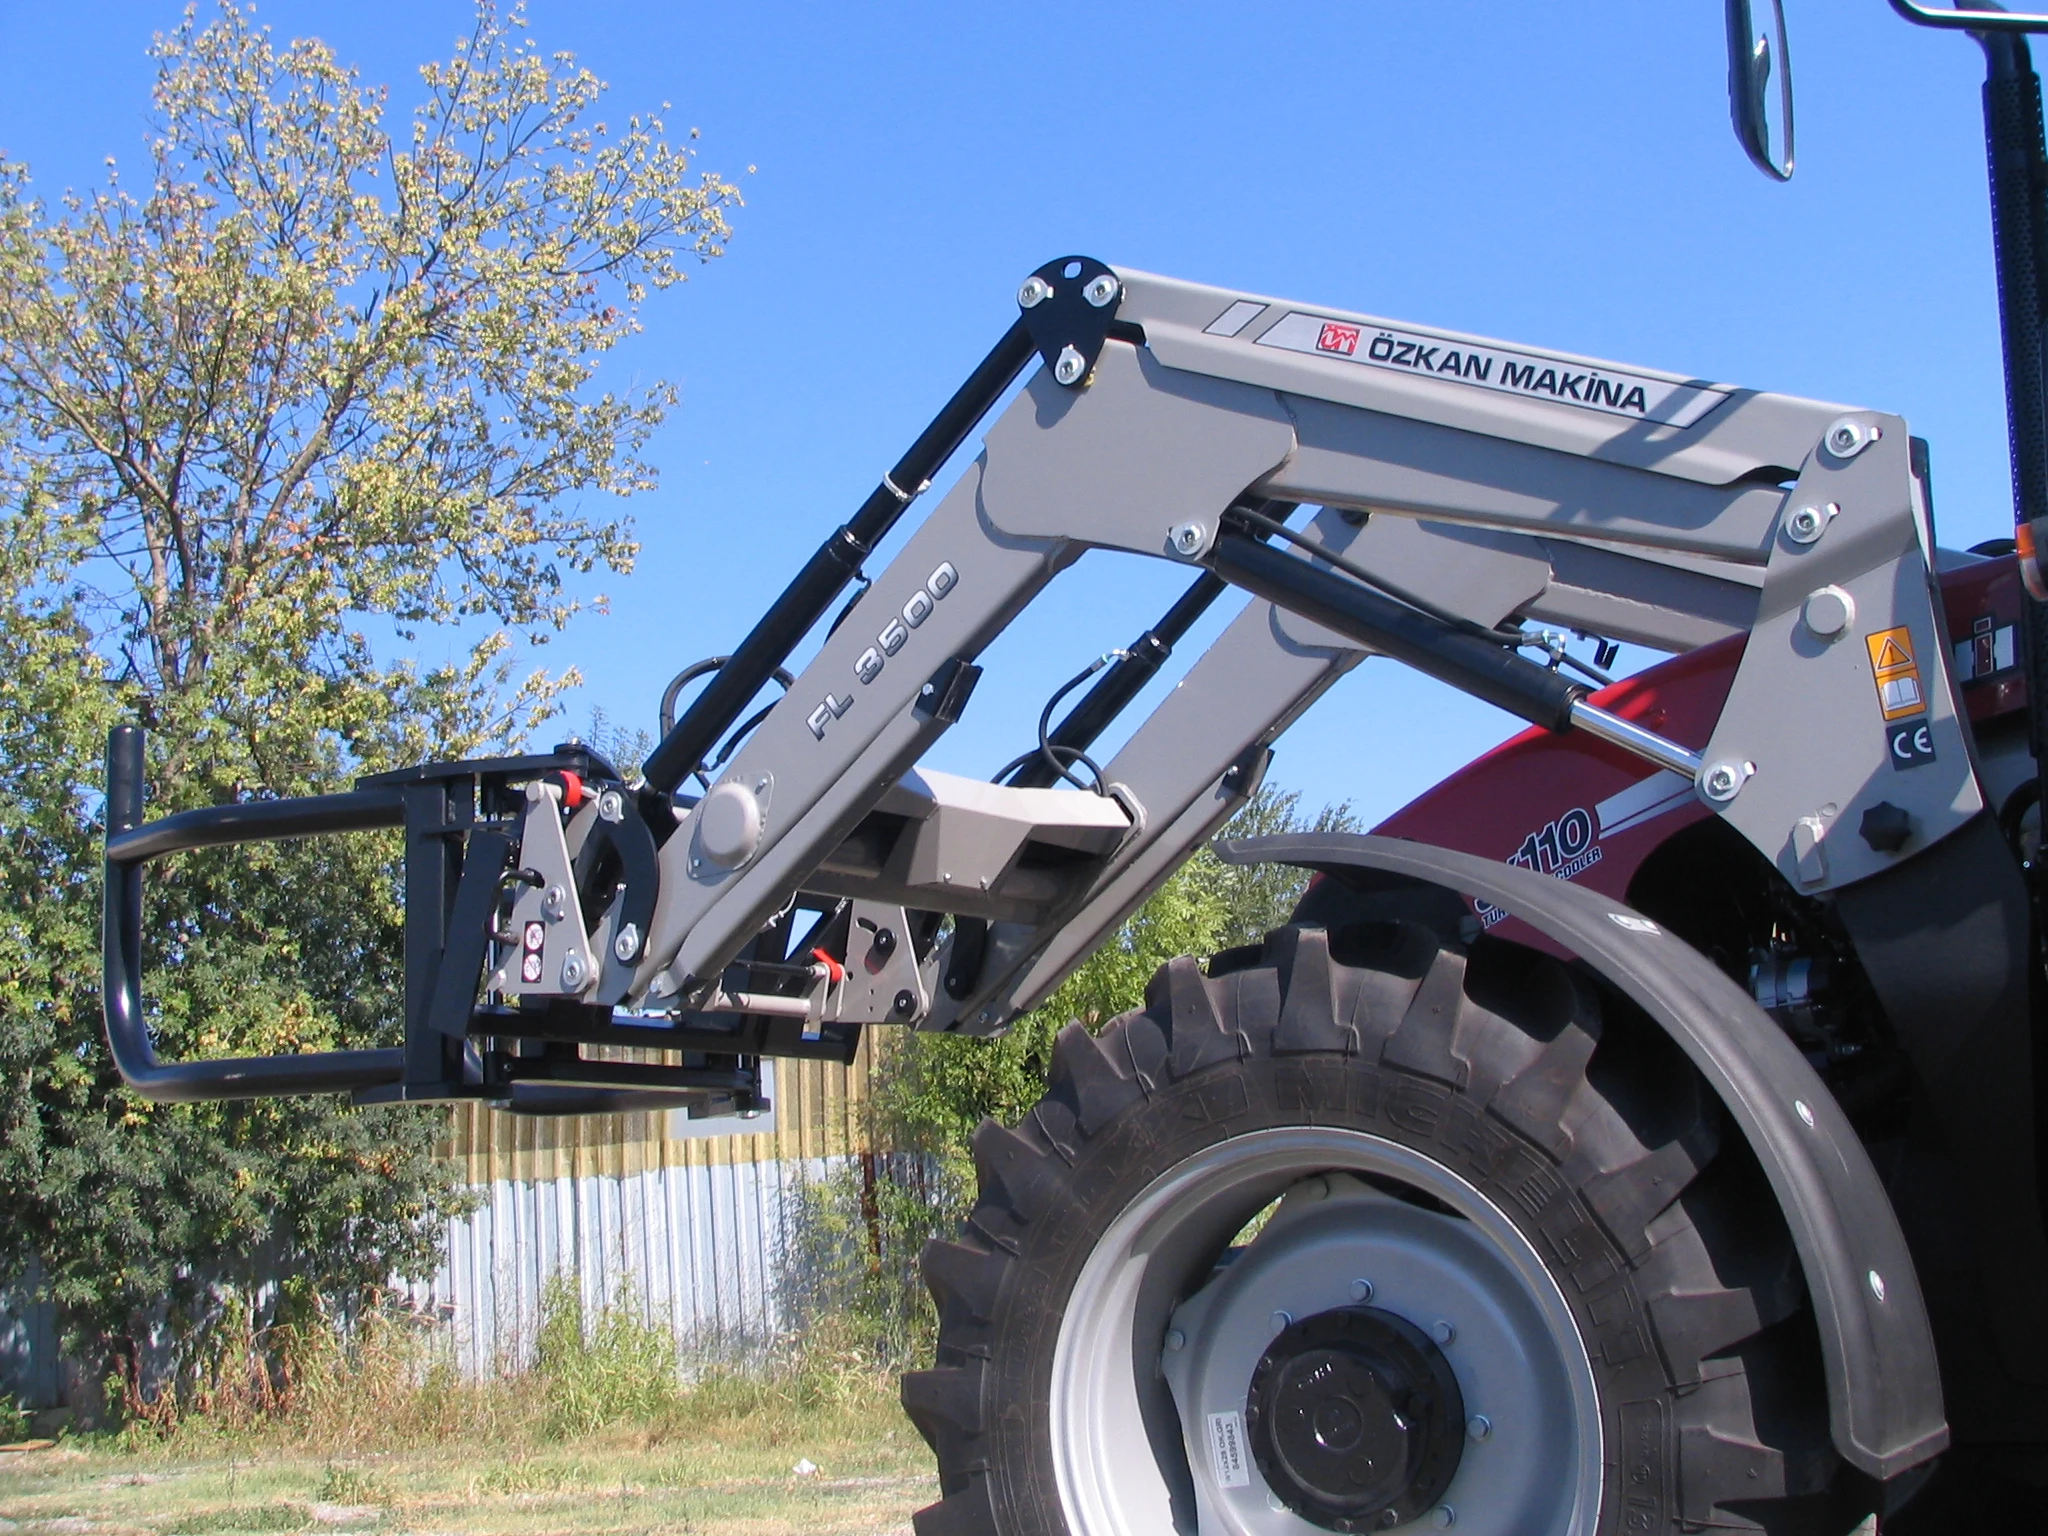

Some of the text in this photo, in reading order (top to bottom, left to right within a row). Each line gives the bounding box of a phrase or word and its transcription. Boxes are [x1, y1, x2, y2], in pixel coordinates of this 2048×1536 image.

[1368, 332, 1493, 380] ÖZKAN
[1500, 361, 1646, 413] MAKİNA
[805, 560, 960, 742] FL 3500
[1893, 726, 1933, 759] CE
[1506, 807, 1592, 875] 110
[1550, 845, 1603, 881] COOLER
